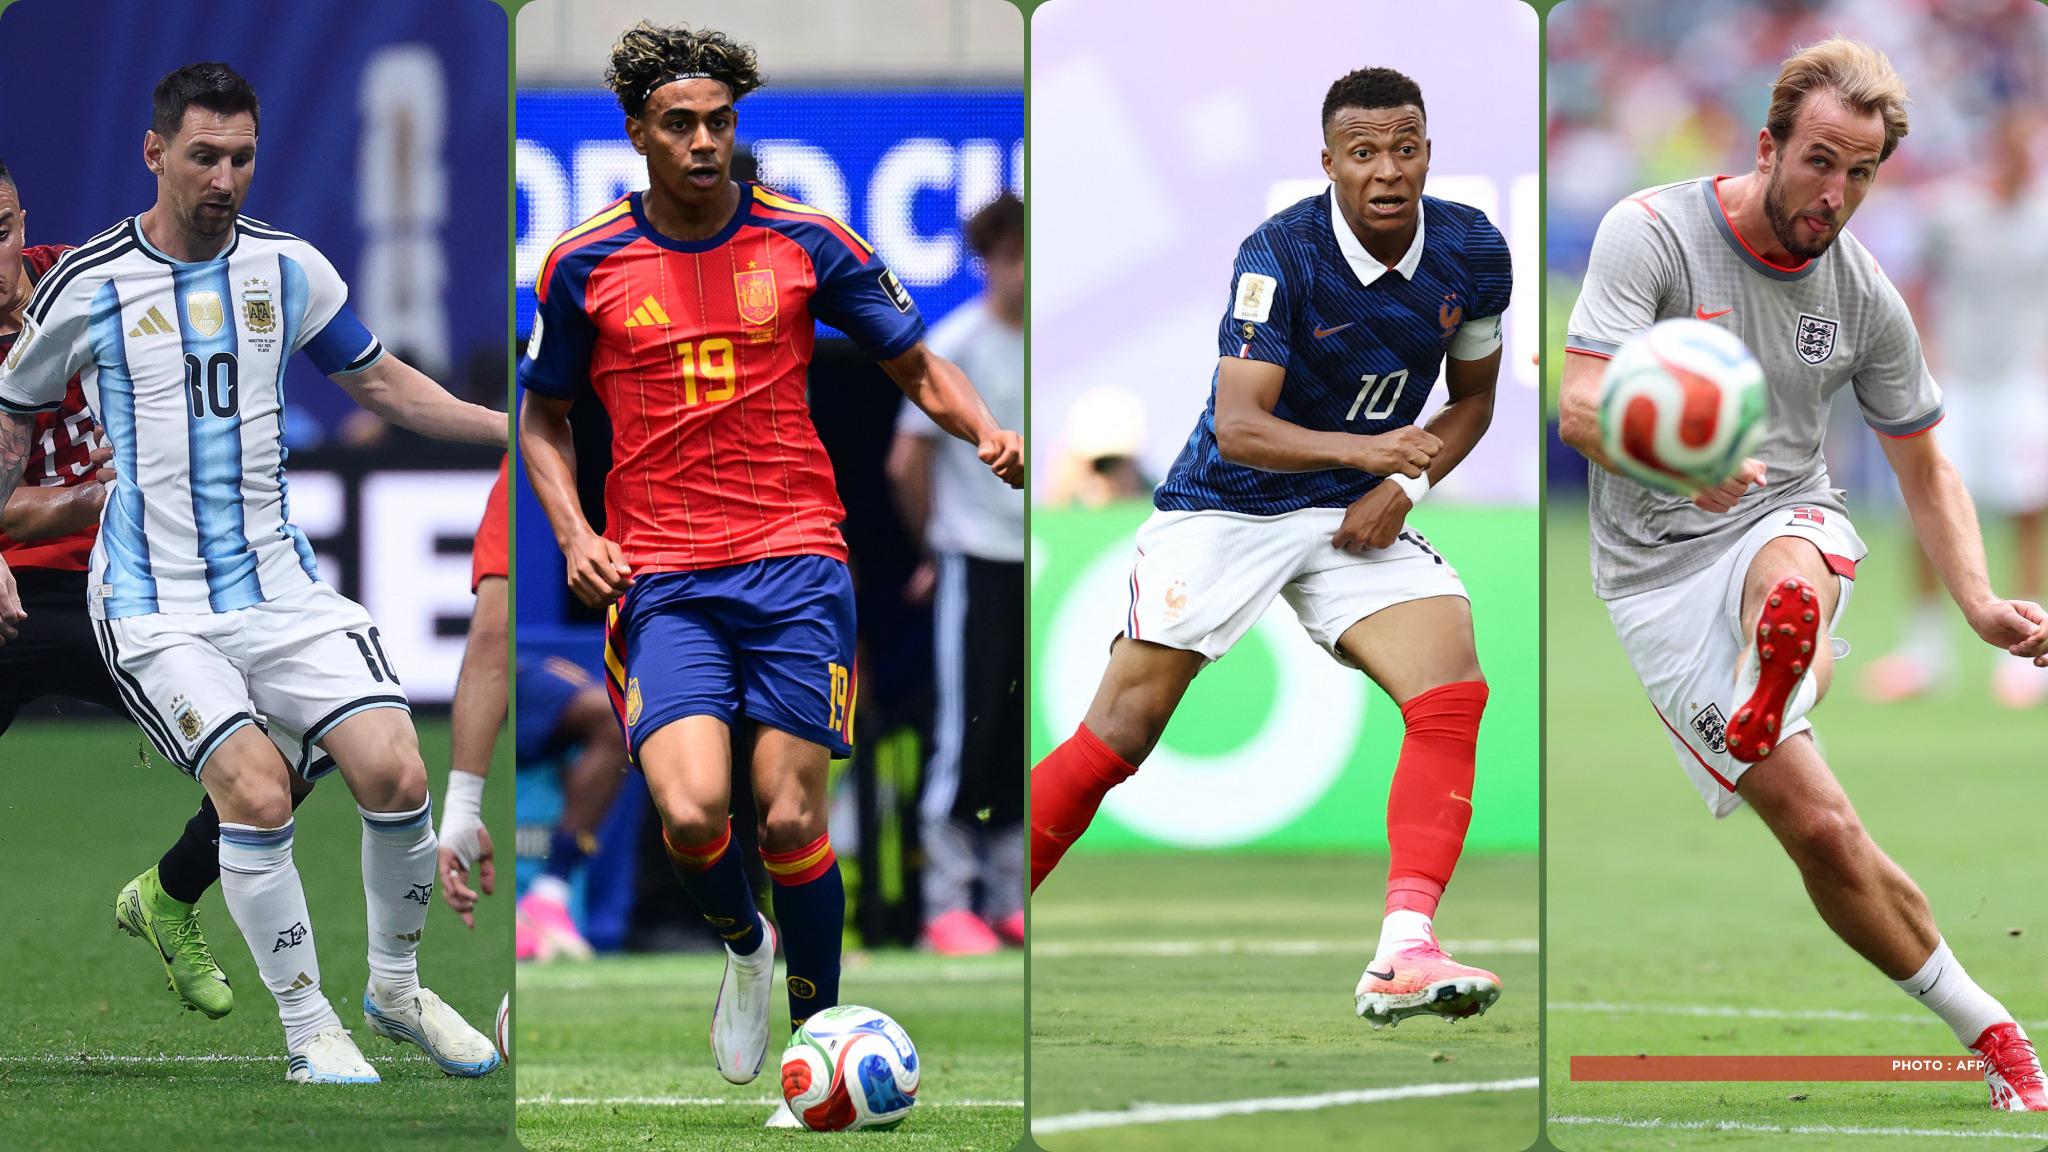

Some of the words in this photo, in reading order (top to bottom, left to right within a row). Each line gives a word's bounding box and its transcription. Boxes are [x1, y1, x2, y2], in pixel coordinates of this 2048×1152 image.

[184, 352, 239, 419] 10
[677, 337, 736, 406] 19
[1345, 368, 1409, 421] 10
[39, 405, 98, 487] 15
[828, 662, 848, 733] 19
[272, 921, 308, 954] AFA
